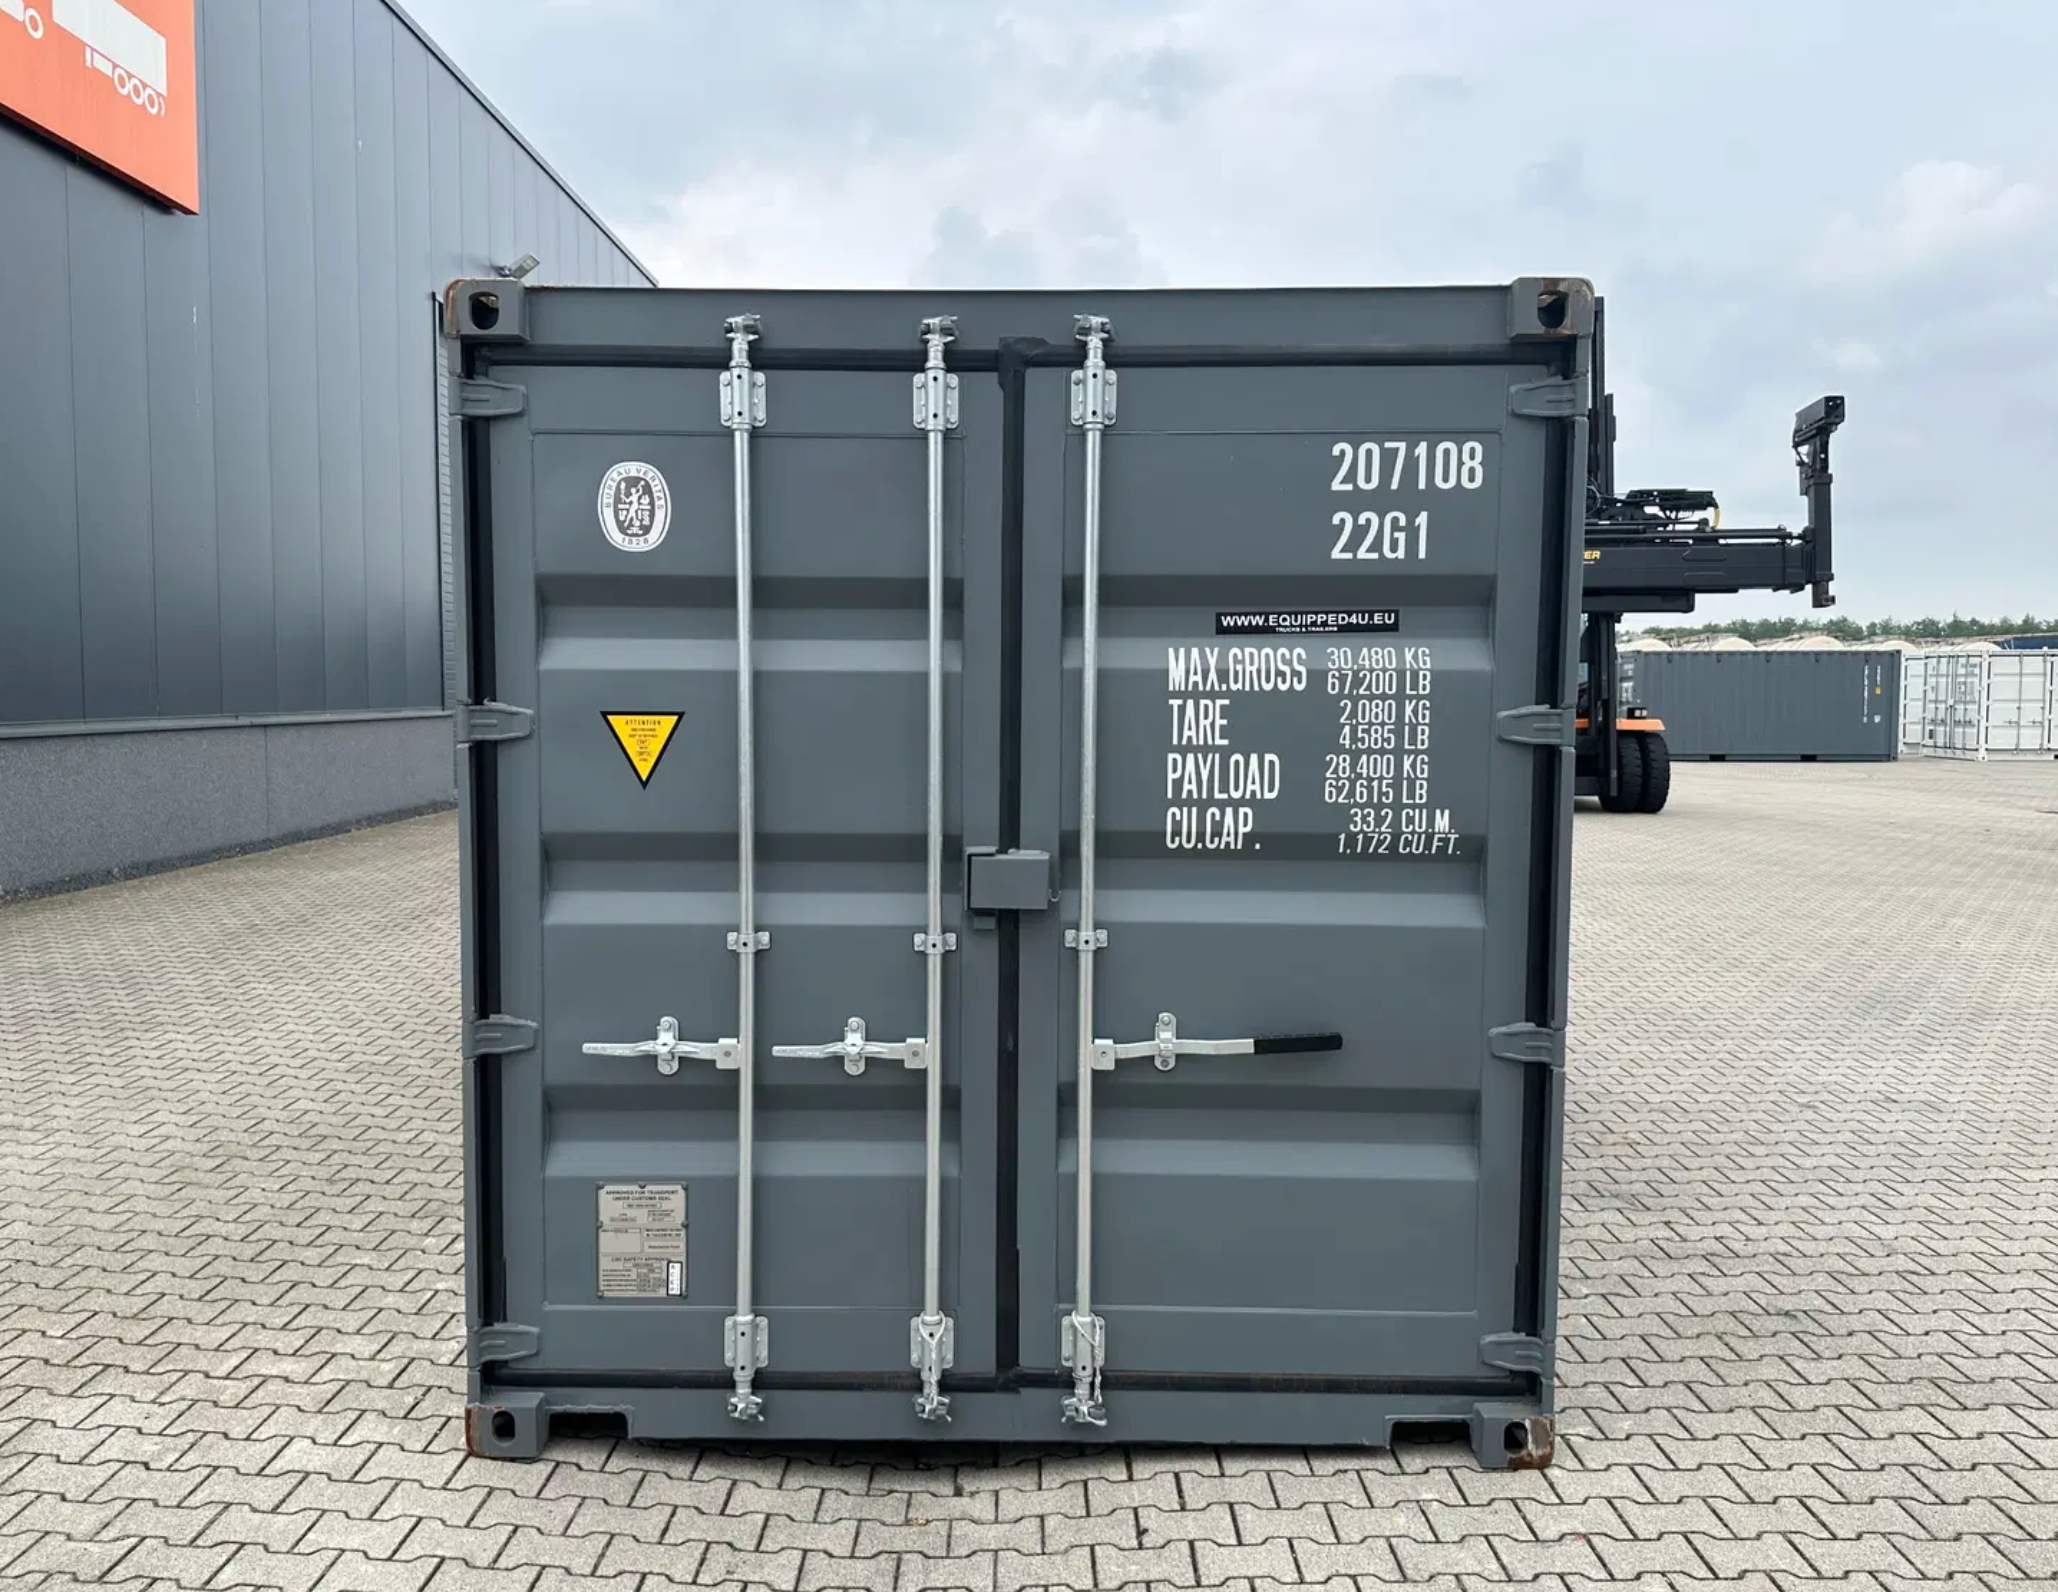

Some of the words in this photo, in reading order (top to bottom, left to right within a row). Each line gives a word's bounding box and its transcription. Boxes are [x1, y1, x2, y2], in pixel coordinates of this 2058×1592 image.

[1331, 440, 1484, 491] 207108
[604, 467, 631, 508] BUREAU
[636, 467, 665, 510] VERITAS
[621, 537, 649, 546] 1828
[1330, 511, 1429, 560] 22G1
[1220, 612, 1396, 627] WWW.EQUIPPED4U.EU
[1167, 646, 1308, 692] MAX.GROSS
[1404, 646, 1432, 670] KG
[1327, 670, 1398, 696] 67,200
[1405, 670, 1432, 695] LB
[1168, 698, 1231, 746] TARE
[1404, 699, 1431, 724] KG
[1338, 724, 1396, 751] 4,585
[1403, 725, 1430, 750] LB
[1166, 752, 1281, 800] PAYLOAD
[1324, 753, 1395, 779] 28,400
[1402, 753, 1430, 779] KG
[1324, 779, 1394, 805] 62,615
[1401, 779, 1428, 804] LB
[1349, 808, 1394, 832] 33.2
[1401, 808, 1456, 833] CU.M.
[1398, 833, 1461, 855] CU.FT.
